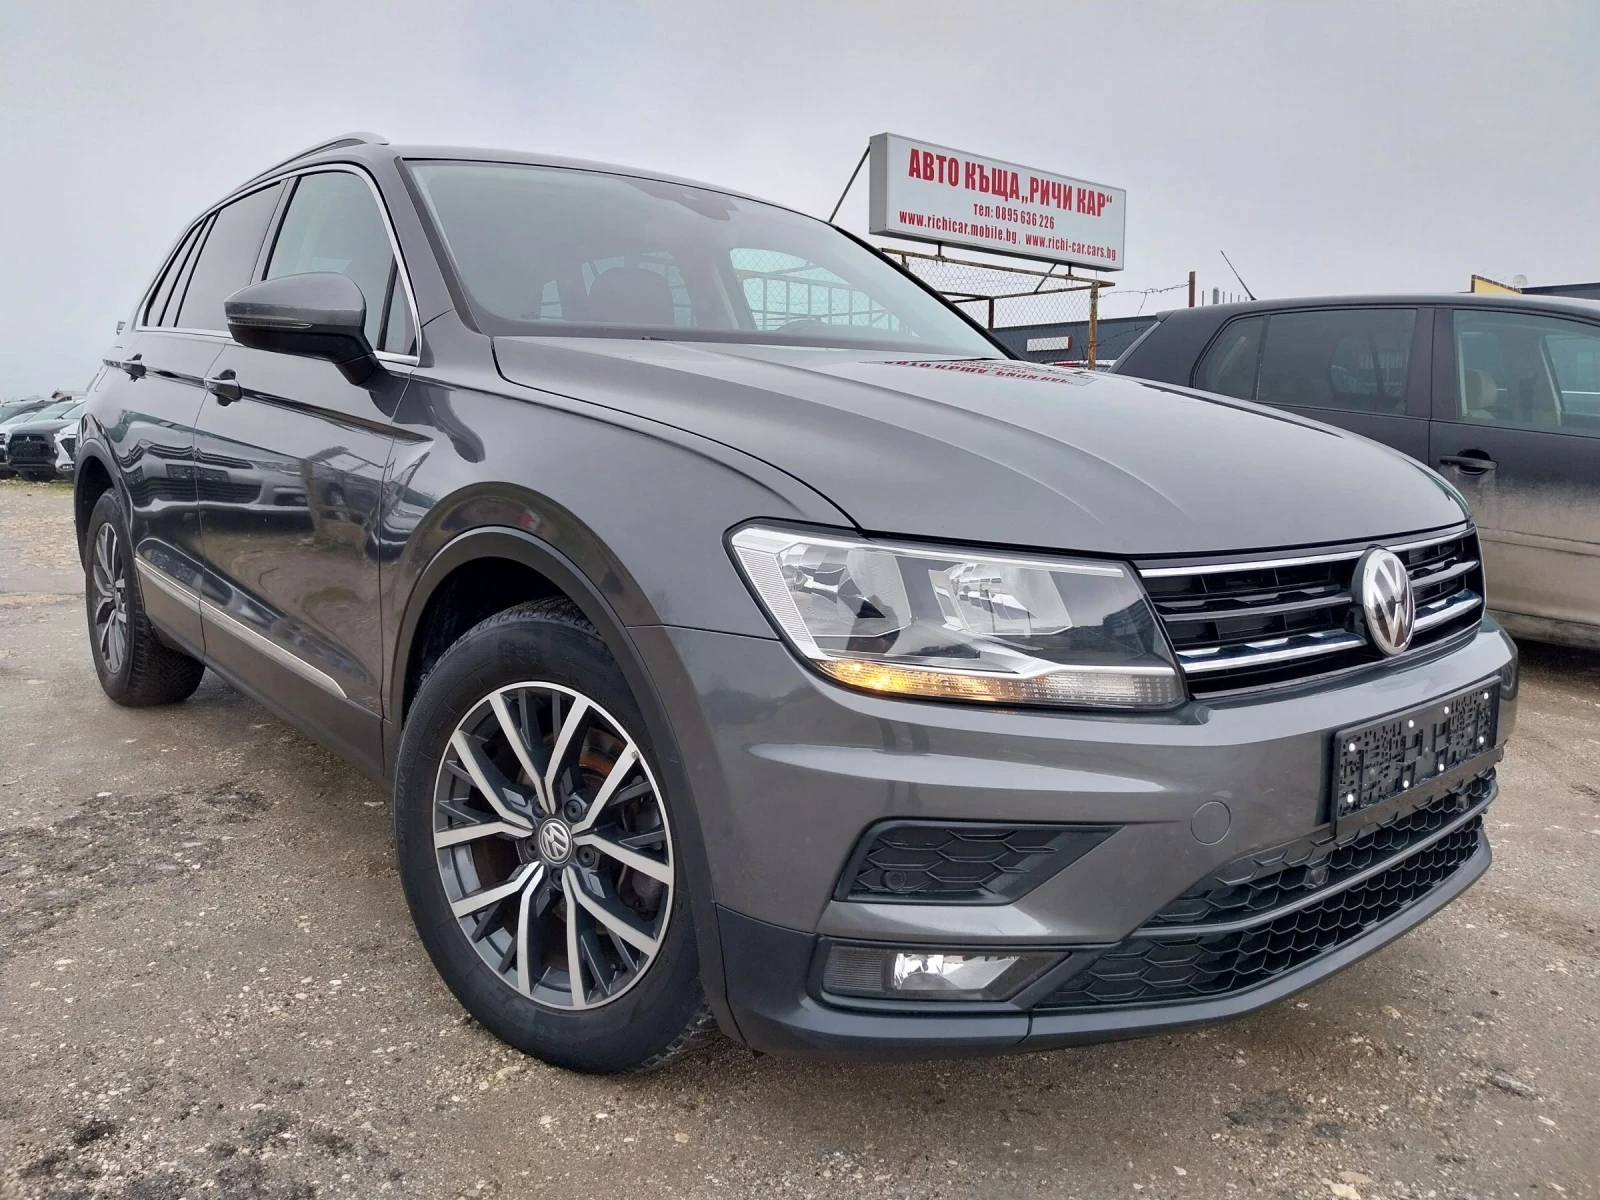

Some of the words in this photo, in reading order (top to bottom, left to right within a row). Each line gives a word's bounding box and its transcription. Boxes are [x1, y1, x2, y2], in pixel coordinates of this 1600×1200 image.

[908, 148, 960, 187] АВТО
[965, 161, 1020, 202] КЪЩА
[995, 205, 1018, 223] 0895
[1020, 210, 1037, 227] 636
[1039, 214, 1055, 230] 226
[1025, 233, 1117, 261] www.richi-car.cars.bg
